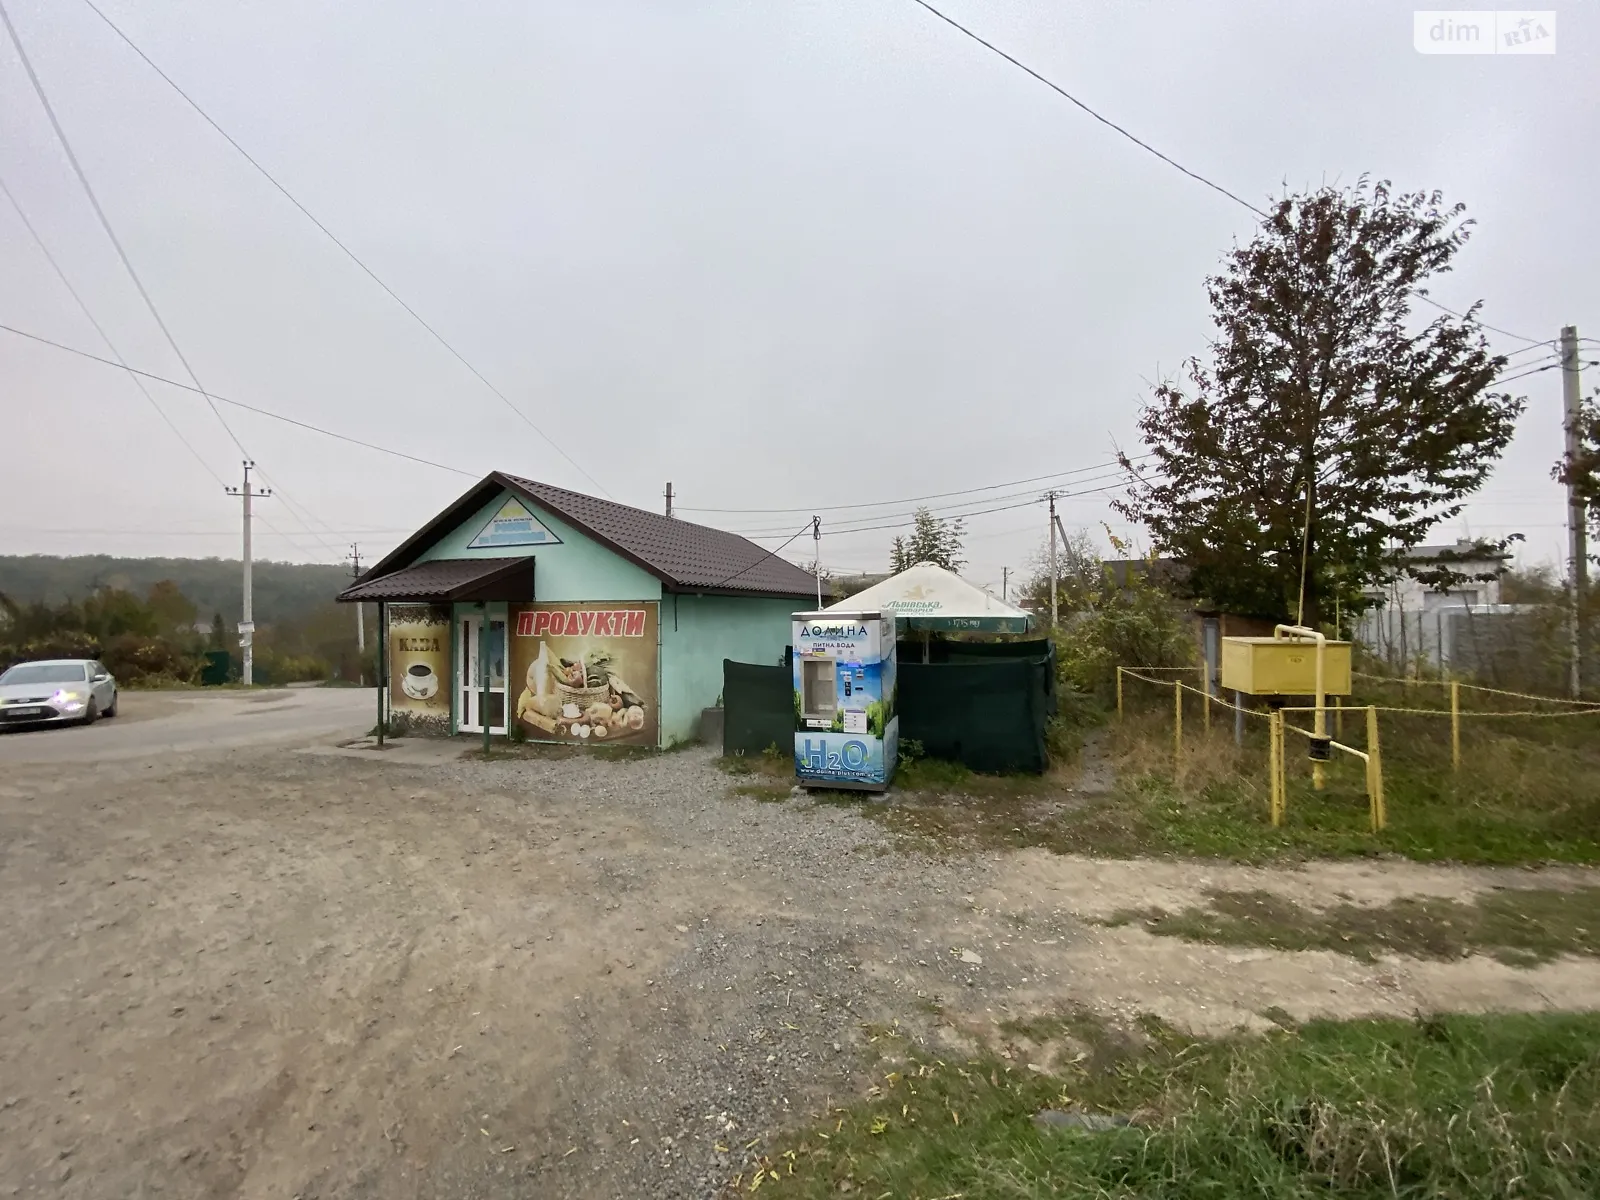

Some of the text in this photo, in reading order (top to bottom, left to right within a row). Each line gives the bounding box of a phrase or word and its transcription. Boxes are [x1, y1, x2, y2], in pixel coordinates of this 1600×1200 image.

[517, 611, 646, 637] ПРОДУКТИ
[801, 625, 868, 638] ДОЛИНА
[398, 637, 441, 653] КАВА
